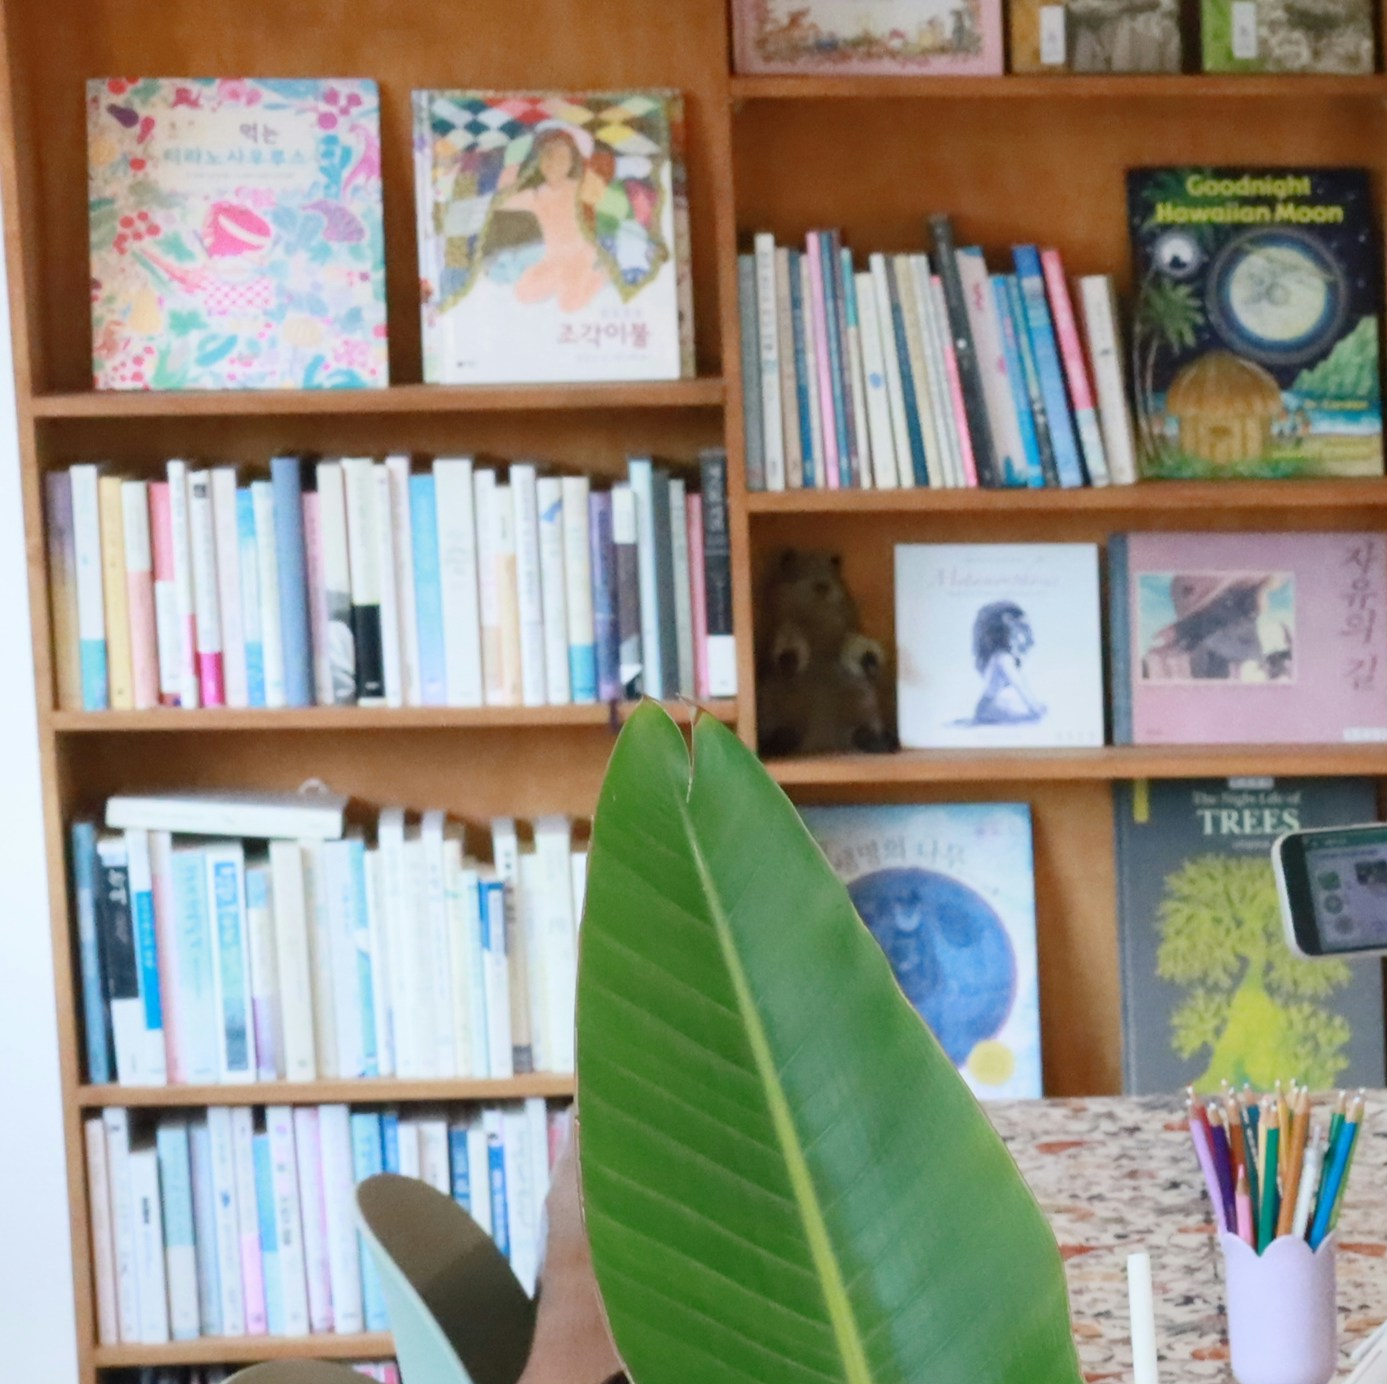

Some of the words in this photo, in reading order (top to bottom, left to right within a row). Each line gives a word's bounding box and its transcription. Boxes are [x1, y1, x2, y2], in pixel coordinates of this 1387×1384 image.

[1185, 175, 1311, 200] Goodnight
[1154, 202, 1271, 224] Hawaiian
[1274, 203, 1345, 224] Moon
[1195, 808, 1301, 836] TREES
